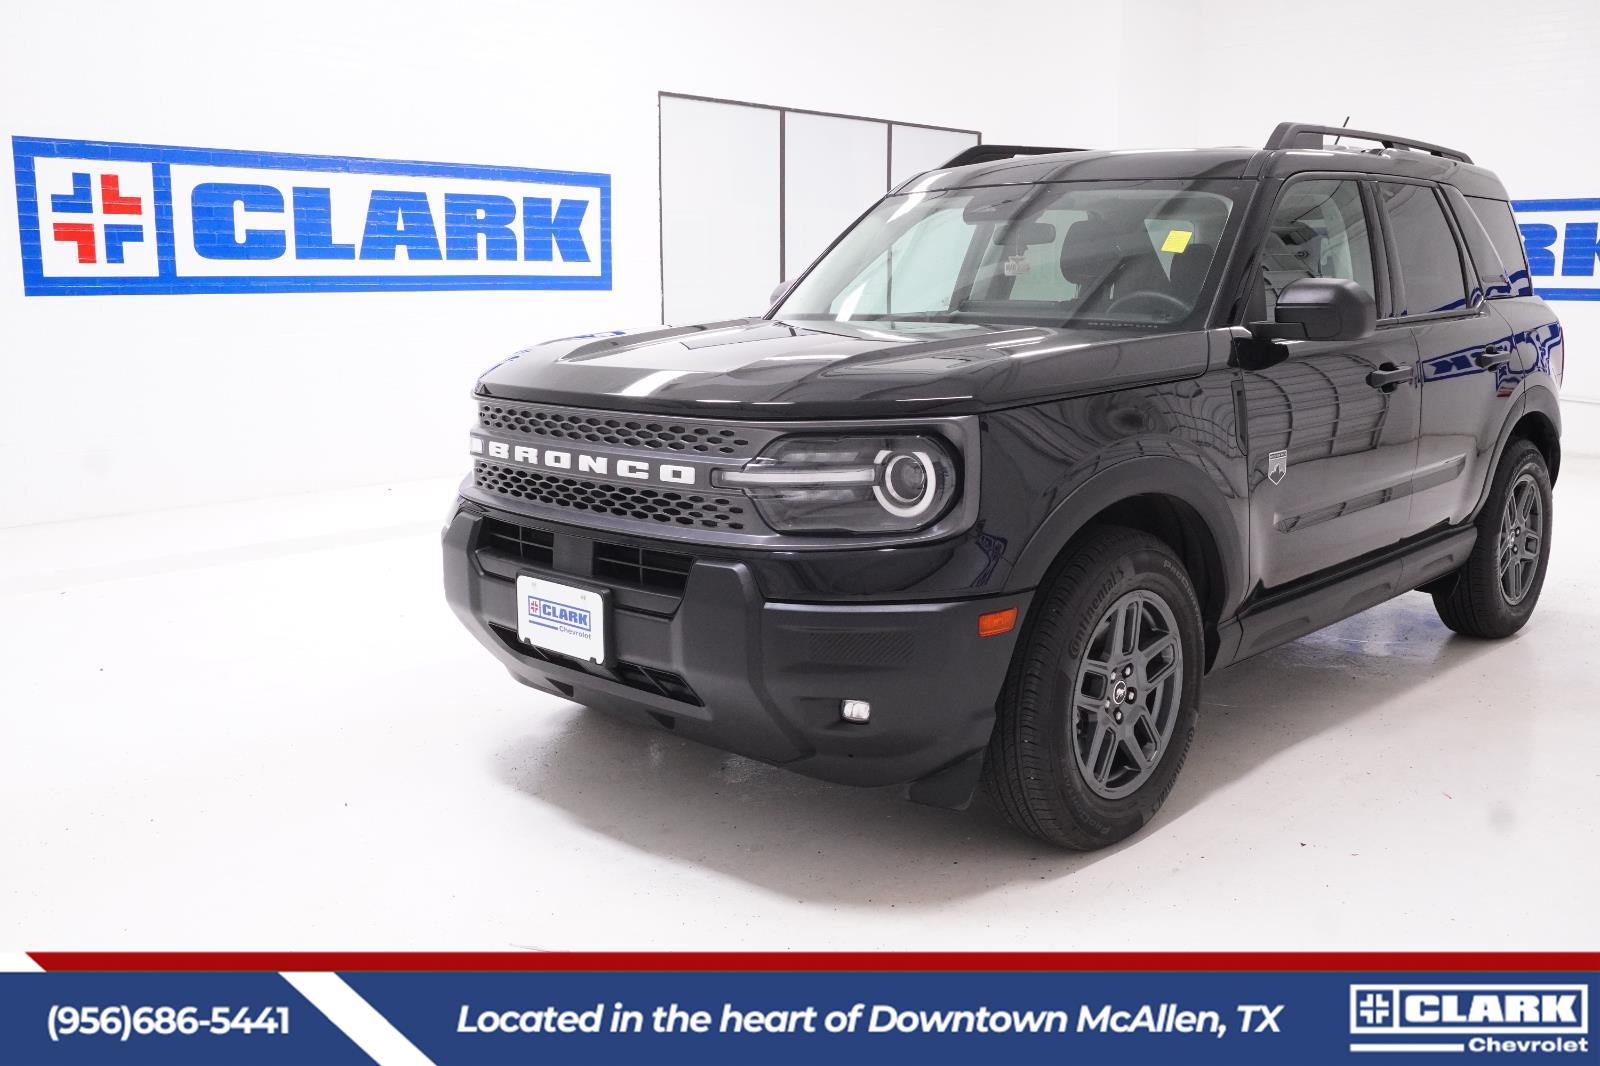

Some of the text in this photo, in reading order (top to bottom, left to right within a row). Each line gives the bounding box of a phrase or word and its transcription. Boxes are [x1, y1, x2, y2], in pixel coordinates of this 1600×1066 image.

[191, 182, 592, 262] CLARK
[488, 441, 696, 485] BRONCO
[542, 603, 588, 627] CLARK
[1069, 570, 1117, 659] Continental
